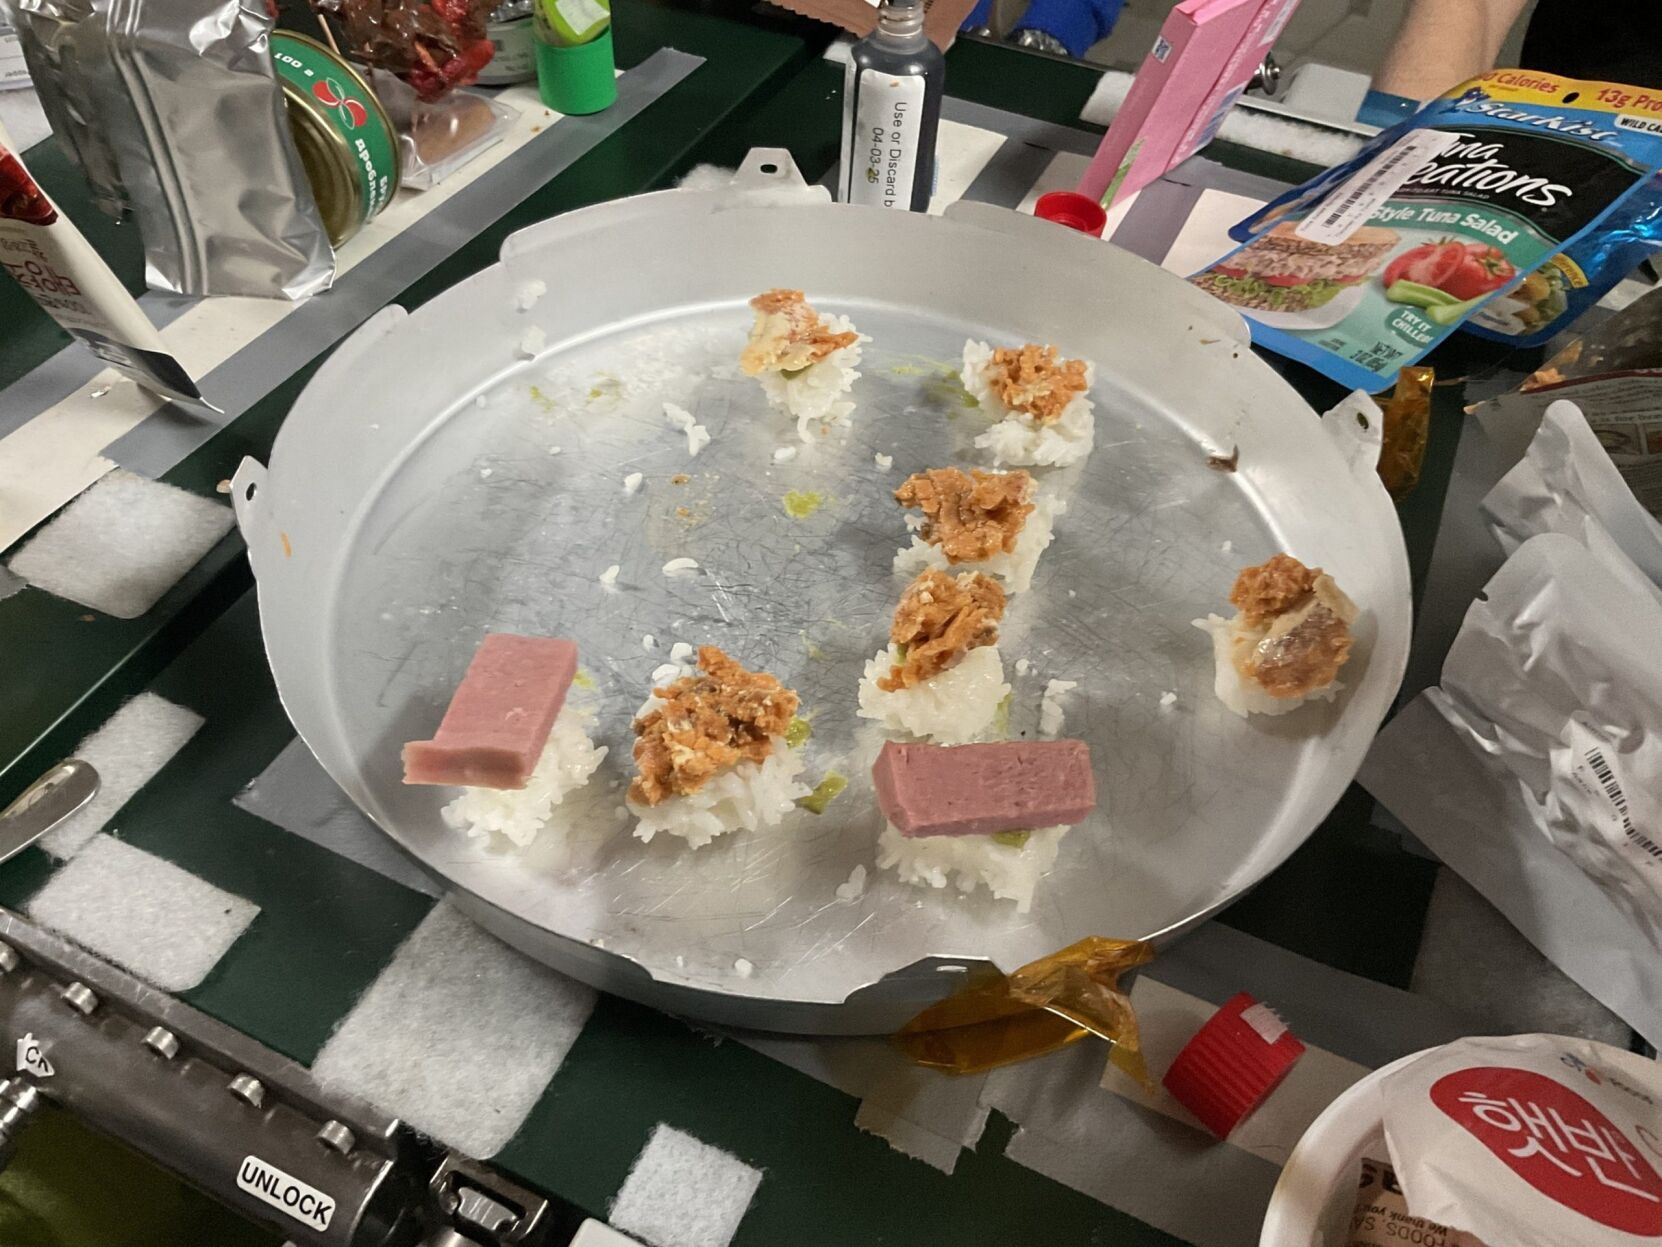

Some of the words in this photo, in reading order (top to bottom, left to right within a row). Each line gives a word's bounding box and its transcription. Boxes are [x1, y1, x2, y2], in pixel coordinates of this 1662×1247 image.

[1498, 72, 1560, 94] Calories
[1597, 88, 1632, 108] 13g
[893, 102, 907, 127] Use
[1620, 117, 1646, 129] WILD
[891, 131, 901, 145] or
[885, 148, 901, 196] Discard
[1404, 158, 1573, 206] eations
[1371, 206, 1416, 222] Style
[1417, 207, 1461, 224] Tuna
[1460, 213, 1520, 245] Salad
[1400, 310, 1422, 326] TRY
[1418, 321, 1432, 332] IT
[1458, 1091, 1660, 1203] 햇반
[242, 1162, 332, 1225] UNLOCK
[1389, 1210, 1425, 1229] thank
